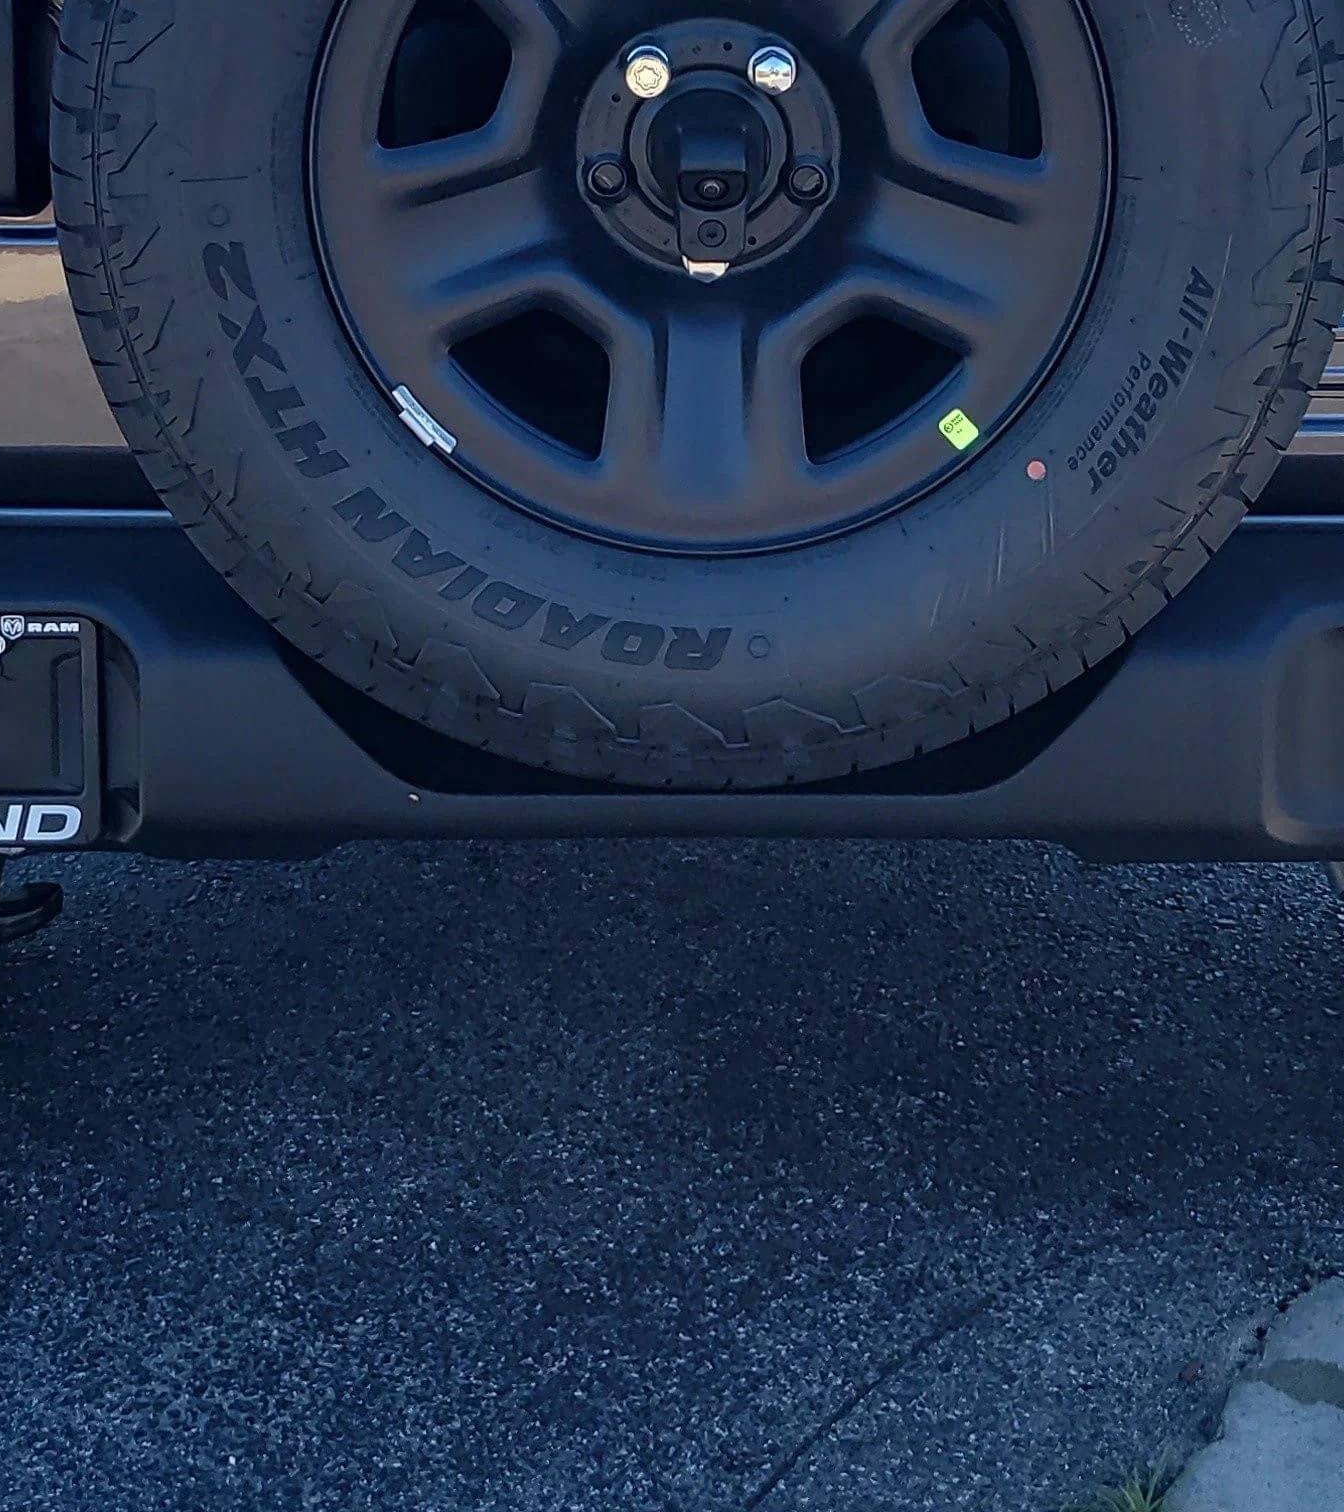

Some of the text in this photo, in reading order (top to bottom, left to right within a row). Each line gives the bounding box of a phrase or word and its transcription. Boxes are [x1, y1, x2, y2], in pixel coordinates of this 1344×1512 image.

[201, 240, 734, 671] ROADIAN HTX2
[1066, 348, 1152, 471] Performance
[1087, 264, 1216, 496] All-Weather
[27, 622, 80, 633] RAM
